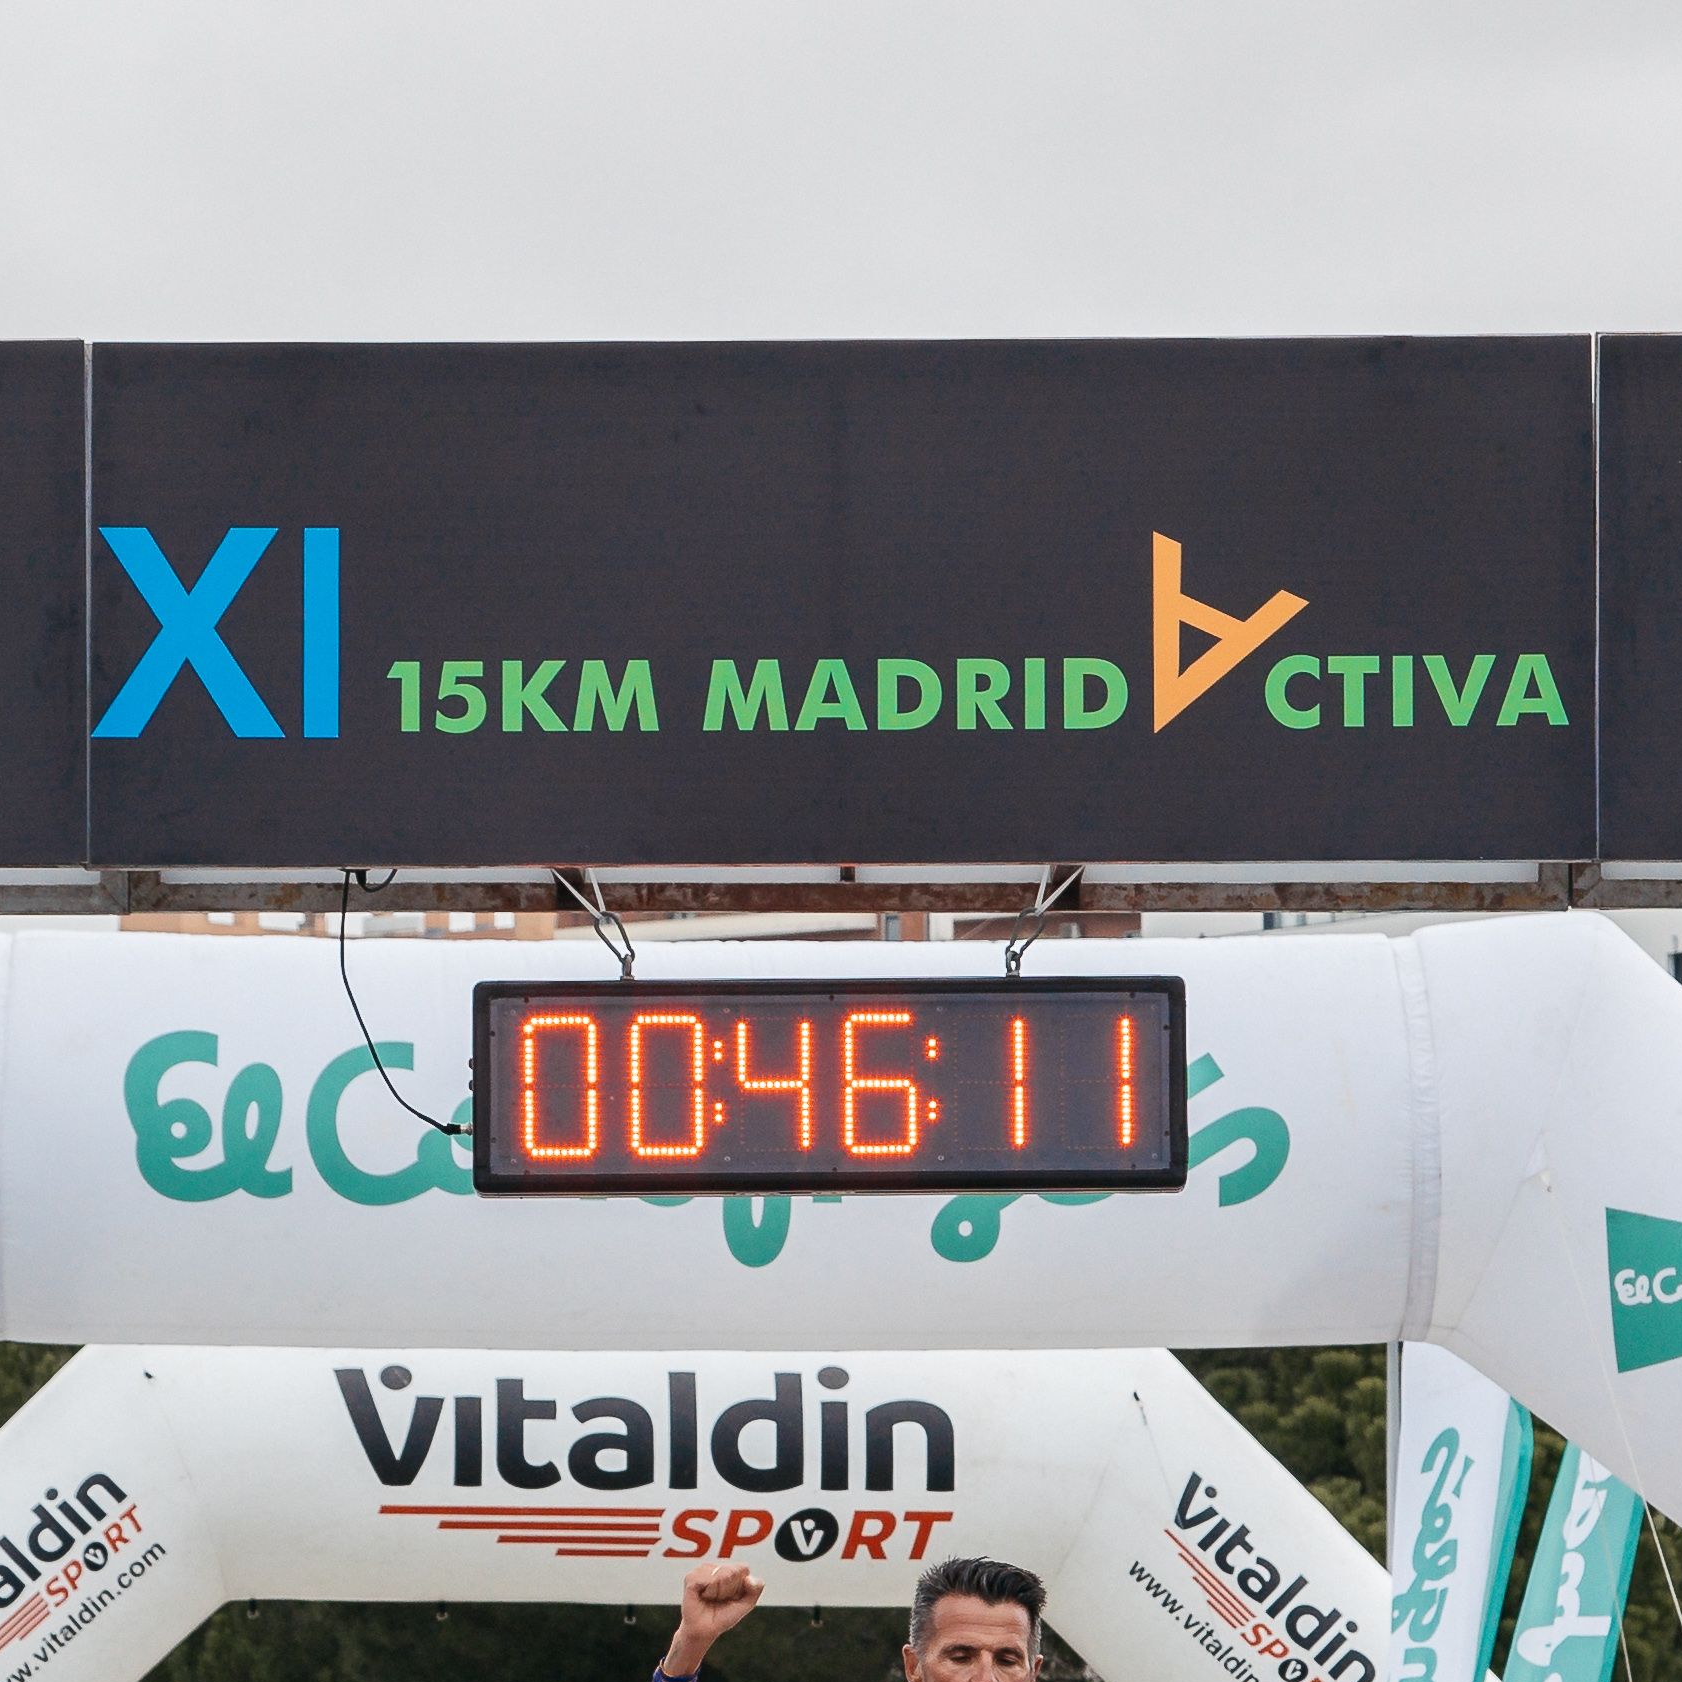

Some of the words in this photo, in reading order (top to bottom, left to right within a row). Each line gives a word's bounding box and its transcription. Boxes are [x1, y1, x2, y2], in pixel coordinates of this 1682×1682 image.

[90, 527, 340, 738] XI
[386, 660, 660, 734] 15KM
[703, 658, 1129, 733] MADRID
[123, 1030, 293, 1200] El
[522, 1012, 1133, 1158] 00:46:11
[1615, 1269, 1652, 1306] El
[333, 1365, 955, 1493] Vitaldin
[44, 1504, 146, 1607] SPORT
[661, 1508, 954, 1562] SPORT
